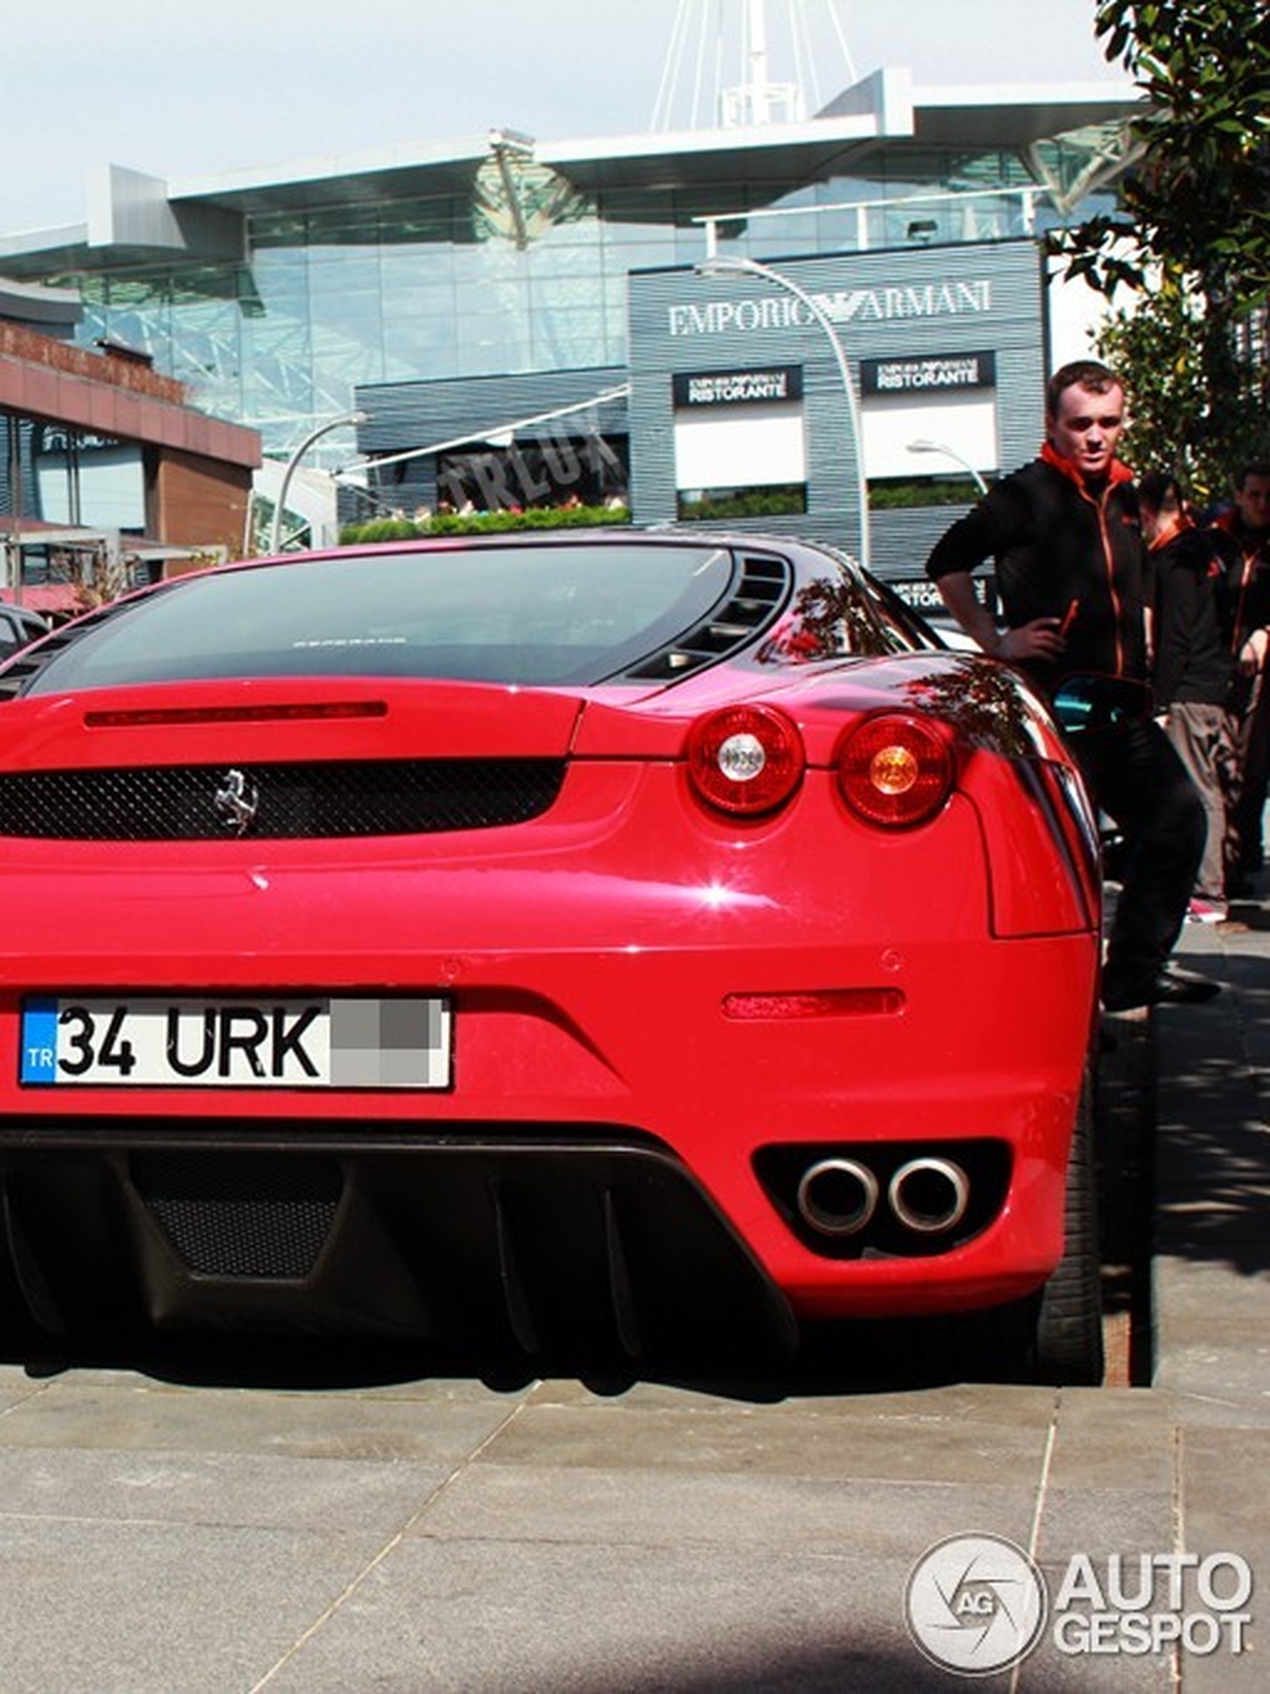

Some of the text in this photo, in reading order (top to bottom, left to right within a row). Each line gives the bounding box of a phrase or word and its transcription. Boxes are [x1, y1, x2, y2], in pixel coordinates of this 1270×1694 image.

[669, 281, 992, 335] EMPORIO ARMANI
[689, 384, 786, 402] RISTORANTE
[877, 369, 978, 389] RISTORANTE
[28, 1006, 321, 1078] TR 34 URK
